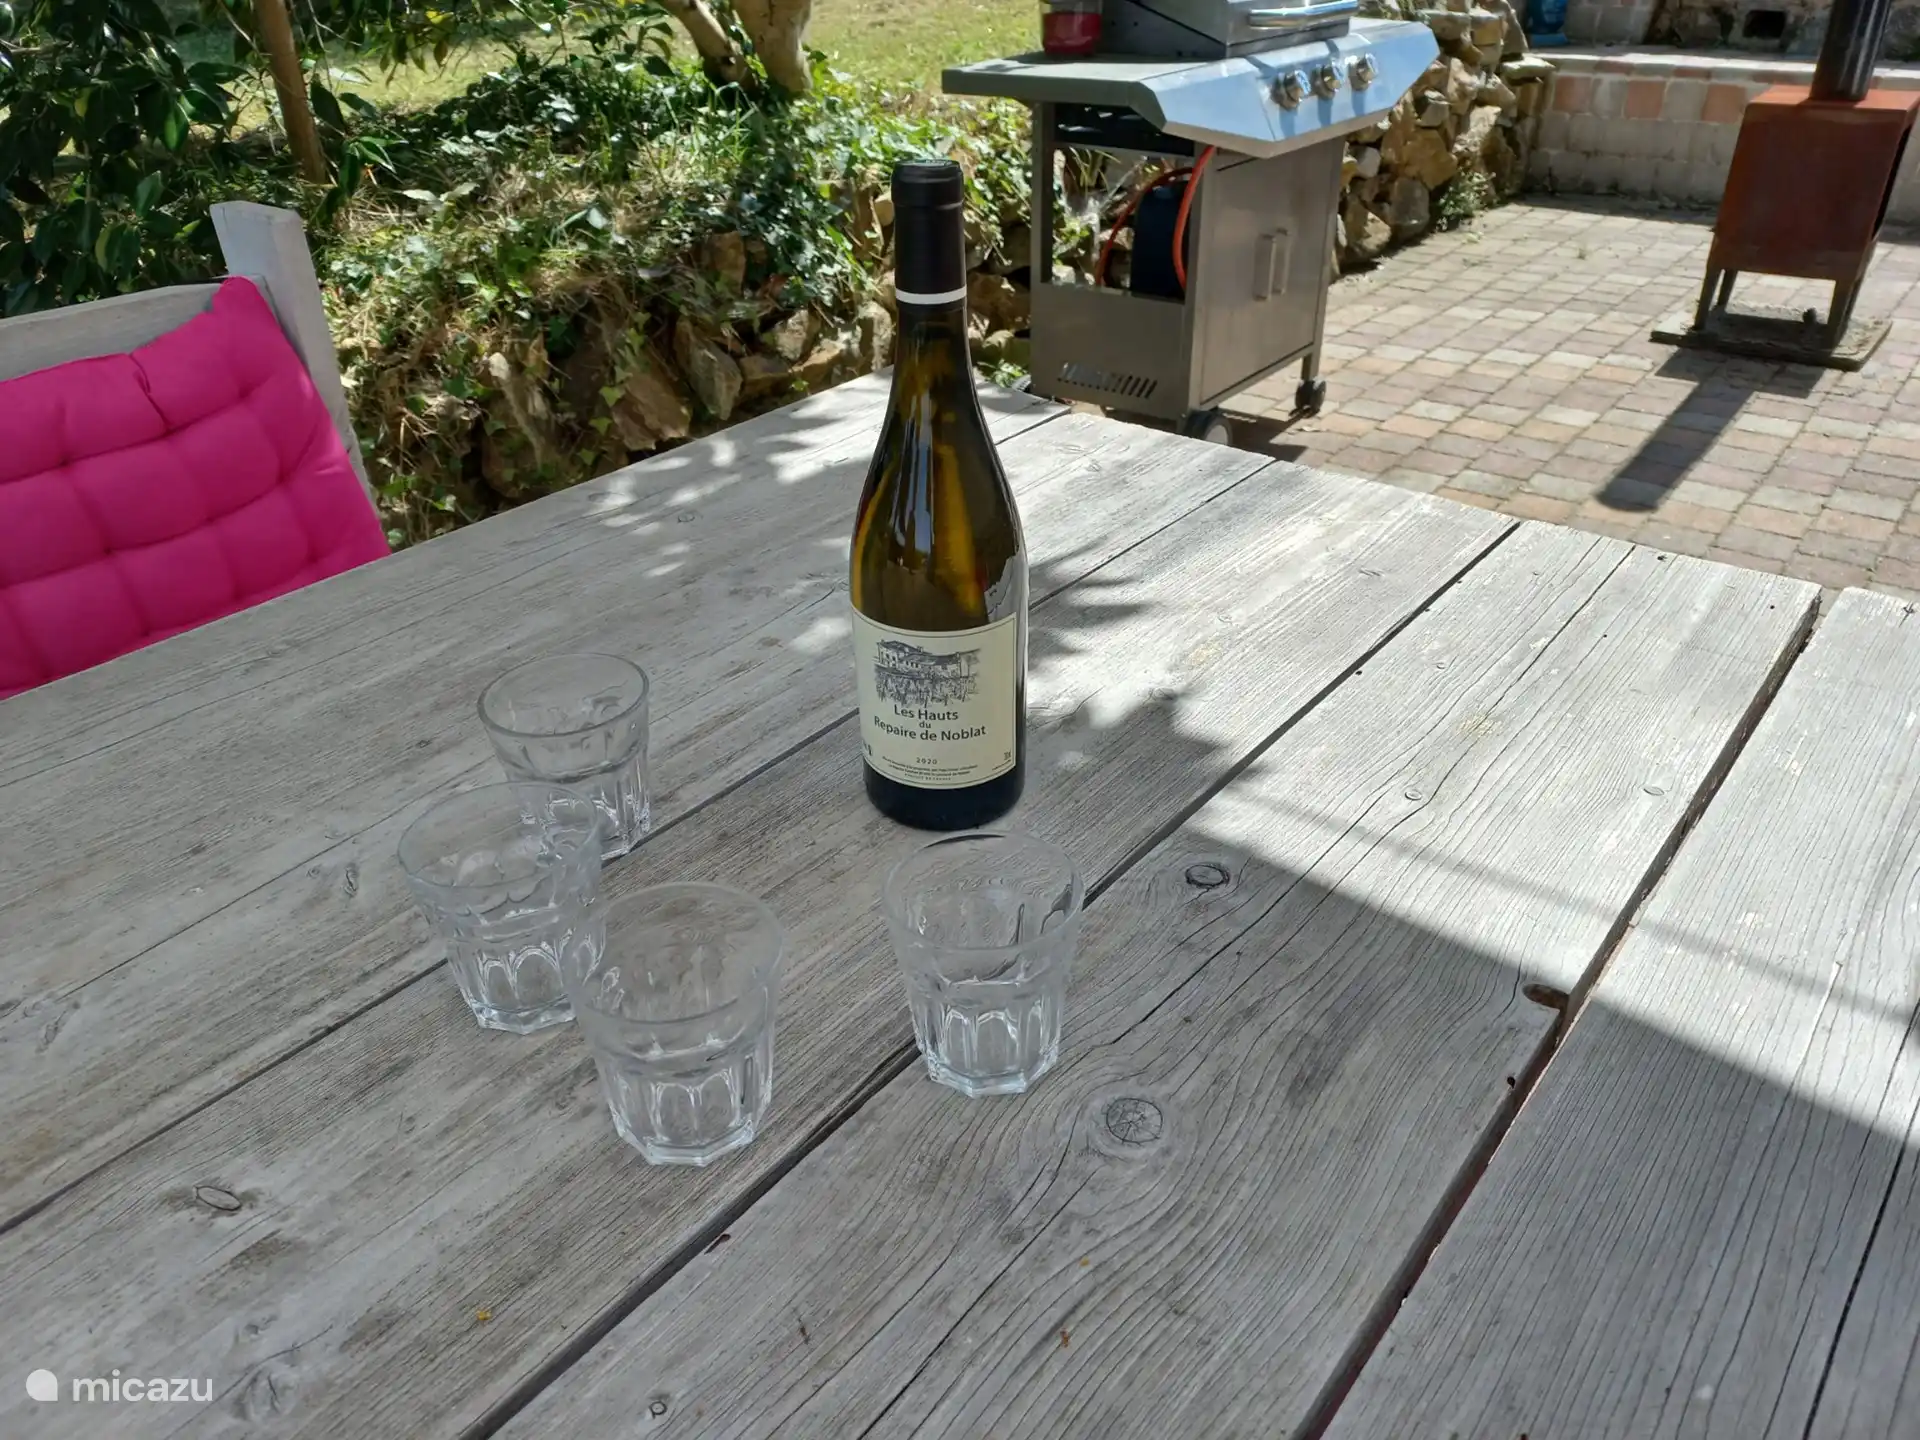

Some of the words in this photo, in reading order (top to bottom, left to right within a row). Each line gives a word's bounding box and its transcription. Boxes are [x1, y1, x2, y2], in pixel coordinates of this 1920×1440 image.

[894, 704, 914, 719] Les
[918, 709, 959, 721] Hauts
[874, 715, 917, 739] Repaire
[920, 729, 938, 741] de
[941, 725, 987, 741] Noblat
[919, 721, 932, 729] du
[916, 757, 938, 765] 2020
